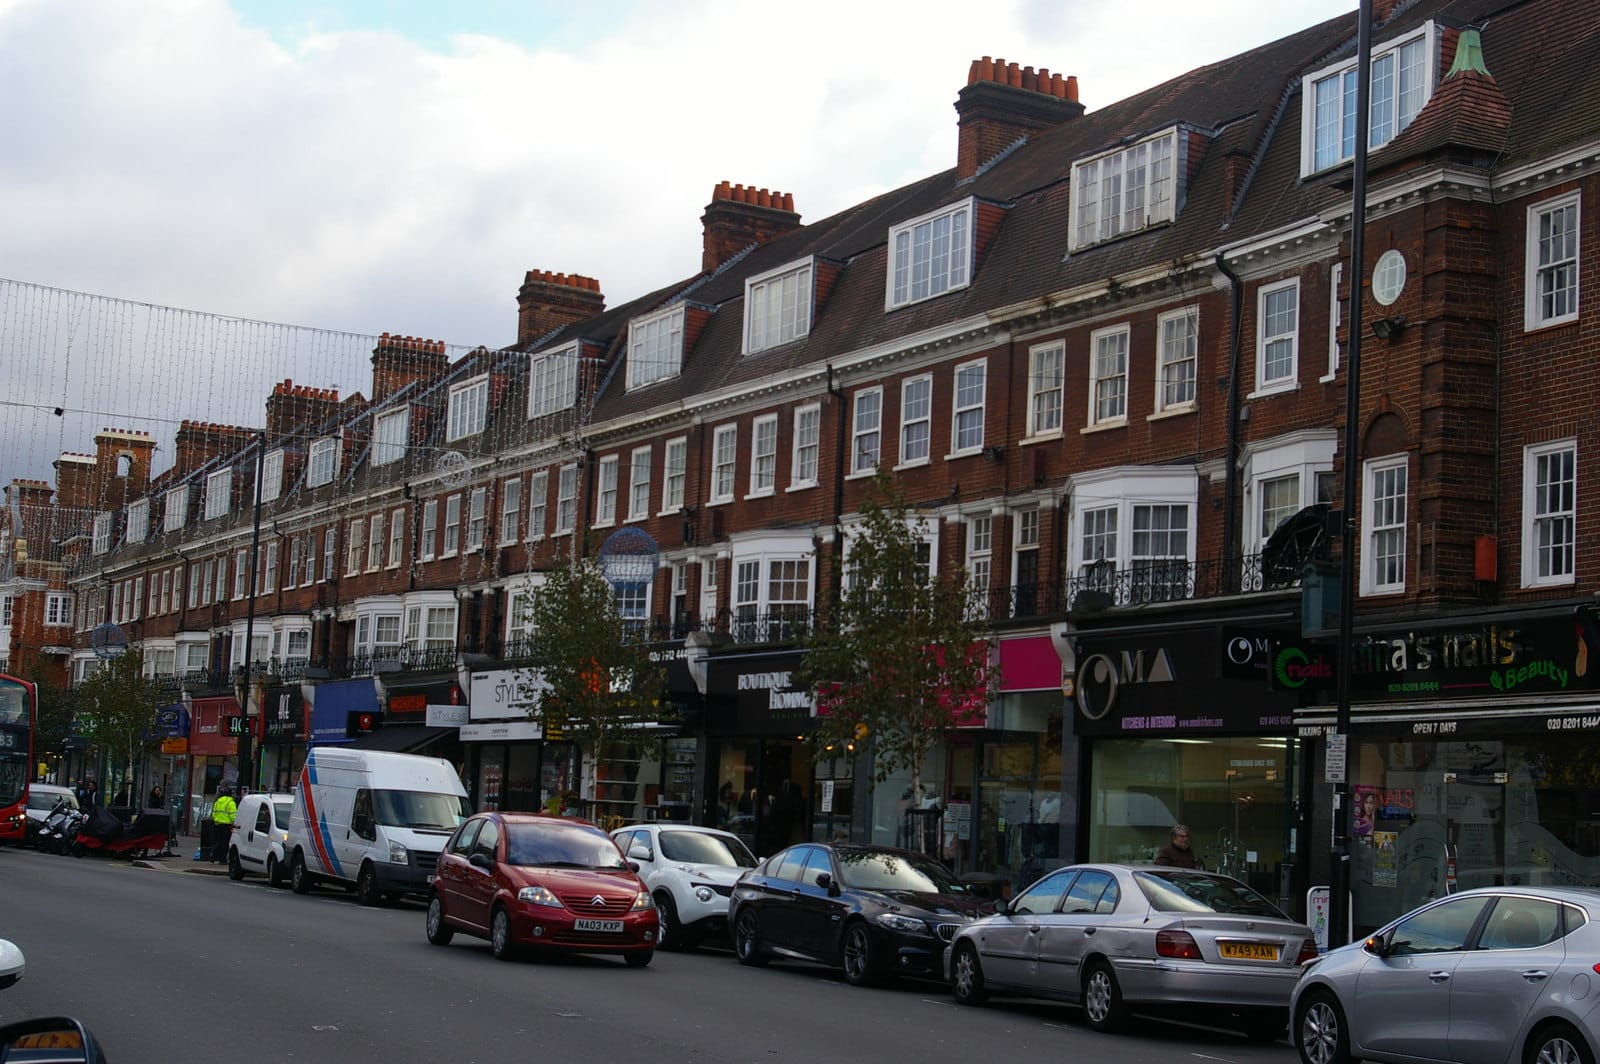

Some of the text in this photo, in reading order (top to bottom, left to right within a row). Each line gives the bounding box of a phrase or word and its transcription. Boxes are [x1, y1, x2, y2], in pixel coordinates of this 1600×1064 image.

[737, 670, 793, 691] BOUTIQUE
[1489, 658, 1569, 692] & Beauty
[1076, 647, 1177, 720] OMA
[1121, 716, 1145, 730] KITCHENS
[1150, 715, 1177, 729] INTERIORS
[1413, 721, 1458, 734] OPEN 7 DAYS
[1547, 717, 1561, 730] 020
[1562, 717, 1580, 729] 8201
[578, 919, 621, 931] NA03 KXP
[1224, 943, 1273, 957] W749 XAN
